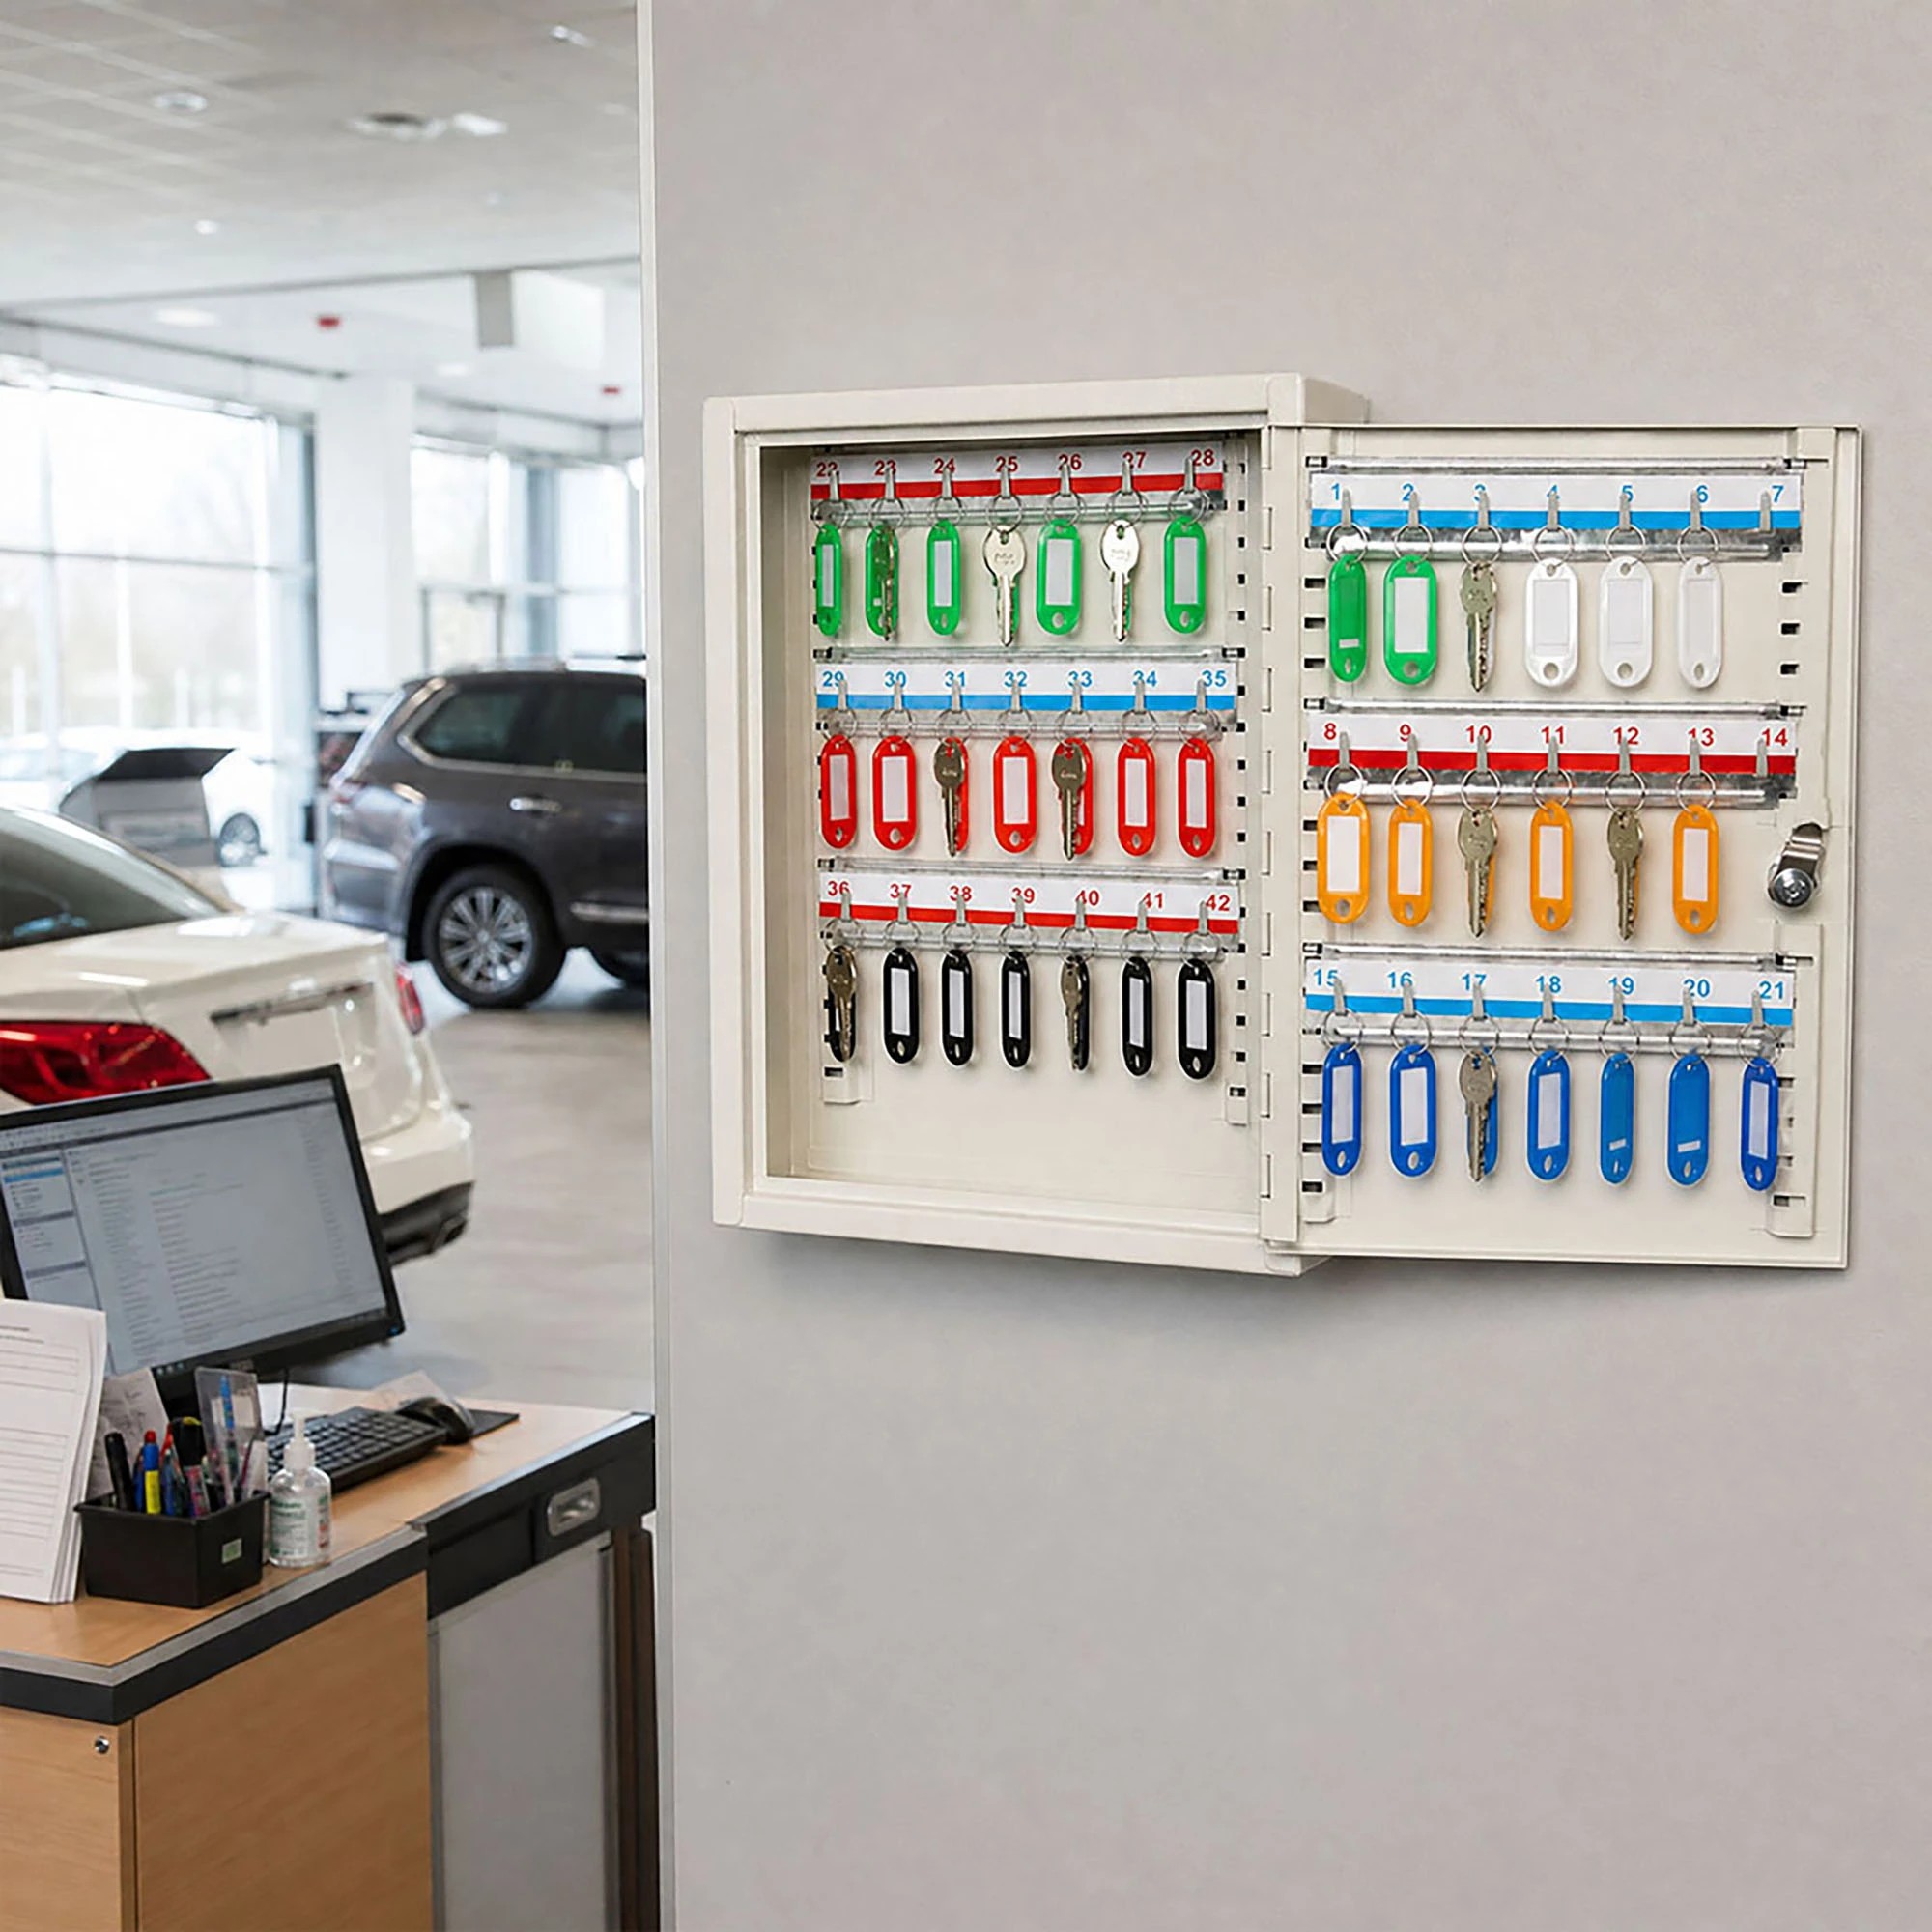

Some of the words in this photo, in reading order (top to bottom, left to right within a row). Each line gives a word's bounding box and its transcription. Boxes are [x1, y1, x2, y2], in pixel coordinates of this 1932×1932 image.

[816, 462, 838, 477] 22
[875, 460, 896, 475] 23
[934, 458, 955, 474] 24
[996, 456, 1018, 472] 25
[1059, 454, 1082, 470] 26
[1122, 452, 1146, 469] 27
[1190, 449, 1214, 466] 28
[1330, 483, 1340, 500] 1
[1402, 484, 1414, 501] 2
[1474, 484, 1486, 501] 3
[1547, 484, 1559, 500] 4
[1621, 485, 1634, 502] 5
[1696, 485, 1709, 502] 6
[1772, 485, 1784, 503] 7
[822, 670, 844, 687] 29
[885, 671, 907, 687] 30
[945, 671, 965, 687] 31
[1004, 671, 1027, 687] 32
[1068, 671, 1093, 687] 33
[1133, 670, 1157, 687] 34
[1202, 670, 1227, 687] 35
[1324, 723, 1336, 740] 8
[1400, 724, 1411, 742] 9
[1466, 725, 1492, 744] 10
[1542, 726, 1564, 744] 11
[1613, 726, 1639, 745] 12
[1688, 727, 1714, 747] 13
[1762, 727, 1788, 747] 14
[828, 881, 849, 896] 36
[890, 883, 912, 898] 37
[950, 886, 972, 902] 38
[1011, 888, 1035, 904] 39
[1075, 890, 1099, 906] 40
[1140, 892, 1163, 908] 41
[1206, 894, 1230, 911] 42
[1313, 969, 1338, 987] 15
[1387, 972, 1413, 988] 16
[1462, 974, 1487, 990] 17
[1536, 975, 1561, 993] 18
[1608, 977, 1634, 995] 19
[1684, 979, 1710, 997] 20
[1759, 981, 1784, 999] 21
